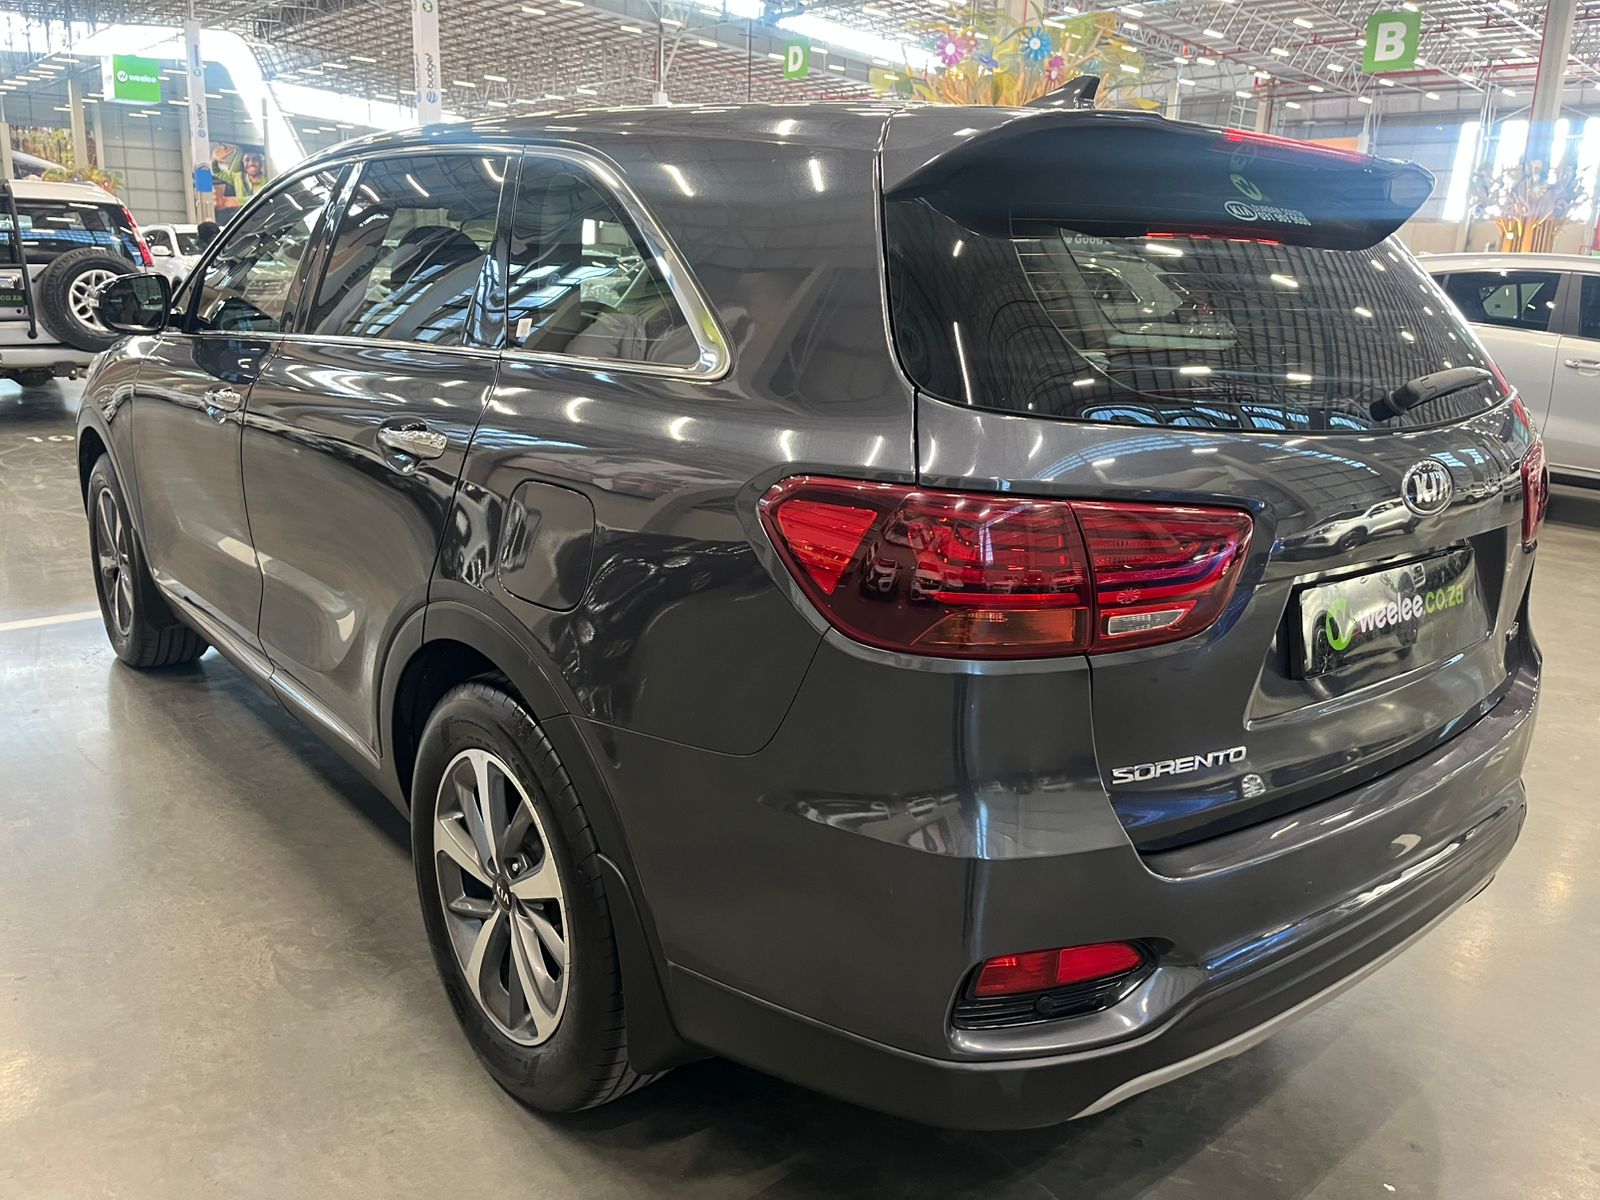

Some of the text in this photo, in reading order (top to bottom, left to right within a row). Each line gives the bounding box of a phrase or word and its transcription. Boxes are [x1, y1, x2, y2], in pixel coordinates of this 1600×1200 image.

[788, 45, 803, 72] D
[1374, 22, 1407, 62] B
[129, 75, 157, 83] weelee
[1412, 470, 1449, 504] KIA
[1358, 583, 1464, 634] weelee.co.za
[1111, 745, 1247, 785] SORENTO
[496, 882, 510, 905] KIA
